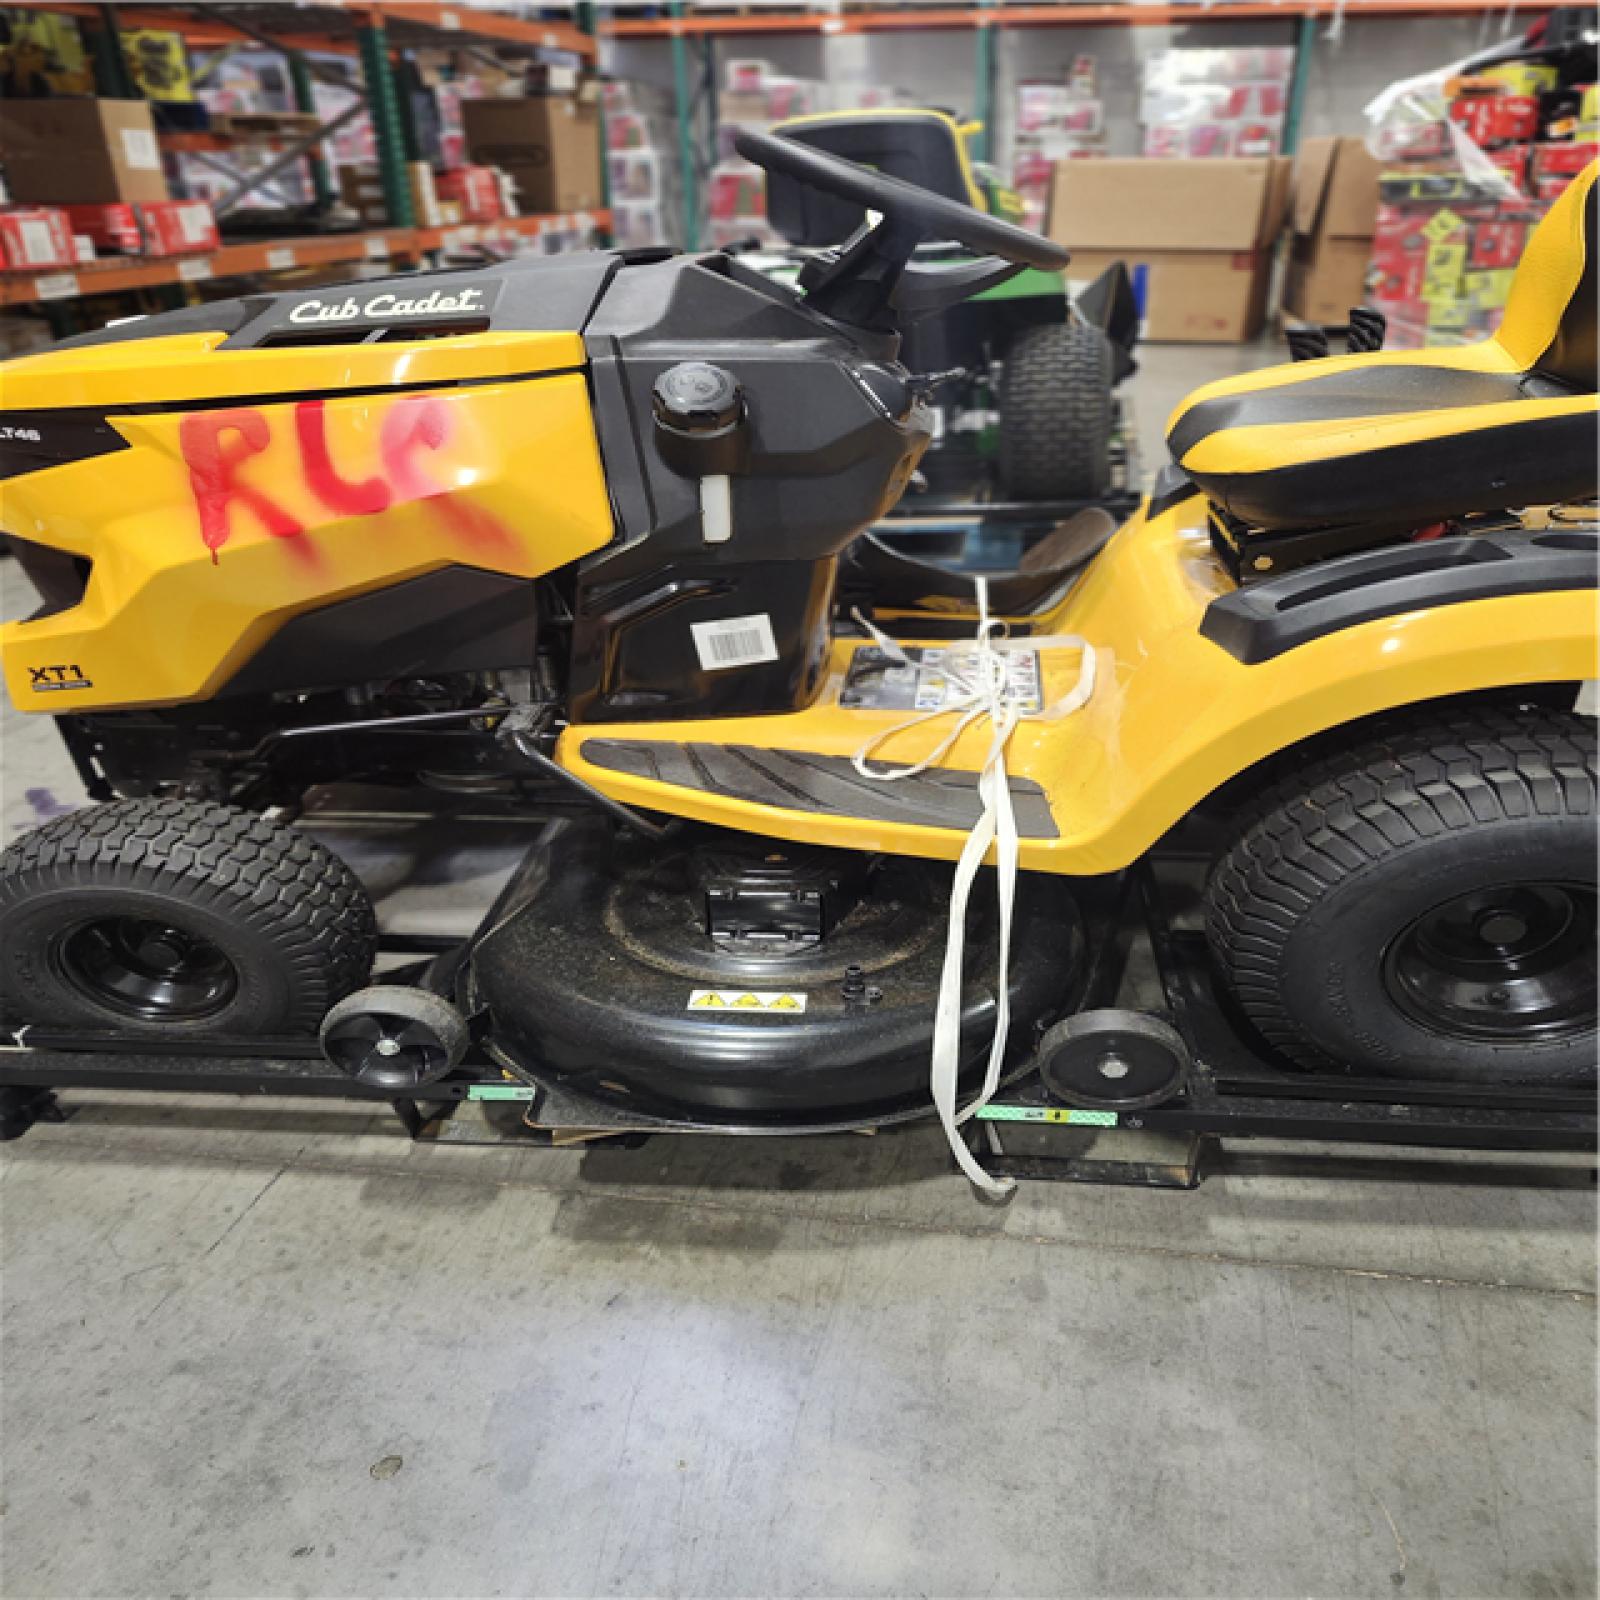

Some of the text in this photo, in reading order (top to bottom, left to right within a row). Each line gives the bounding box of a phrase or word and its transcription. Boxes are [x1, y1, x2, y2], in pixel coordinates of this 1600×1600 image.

[289, 288, 483, 323] Cub Cadet
[27, 665, 84, 683] XT1
